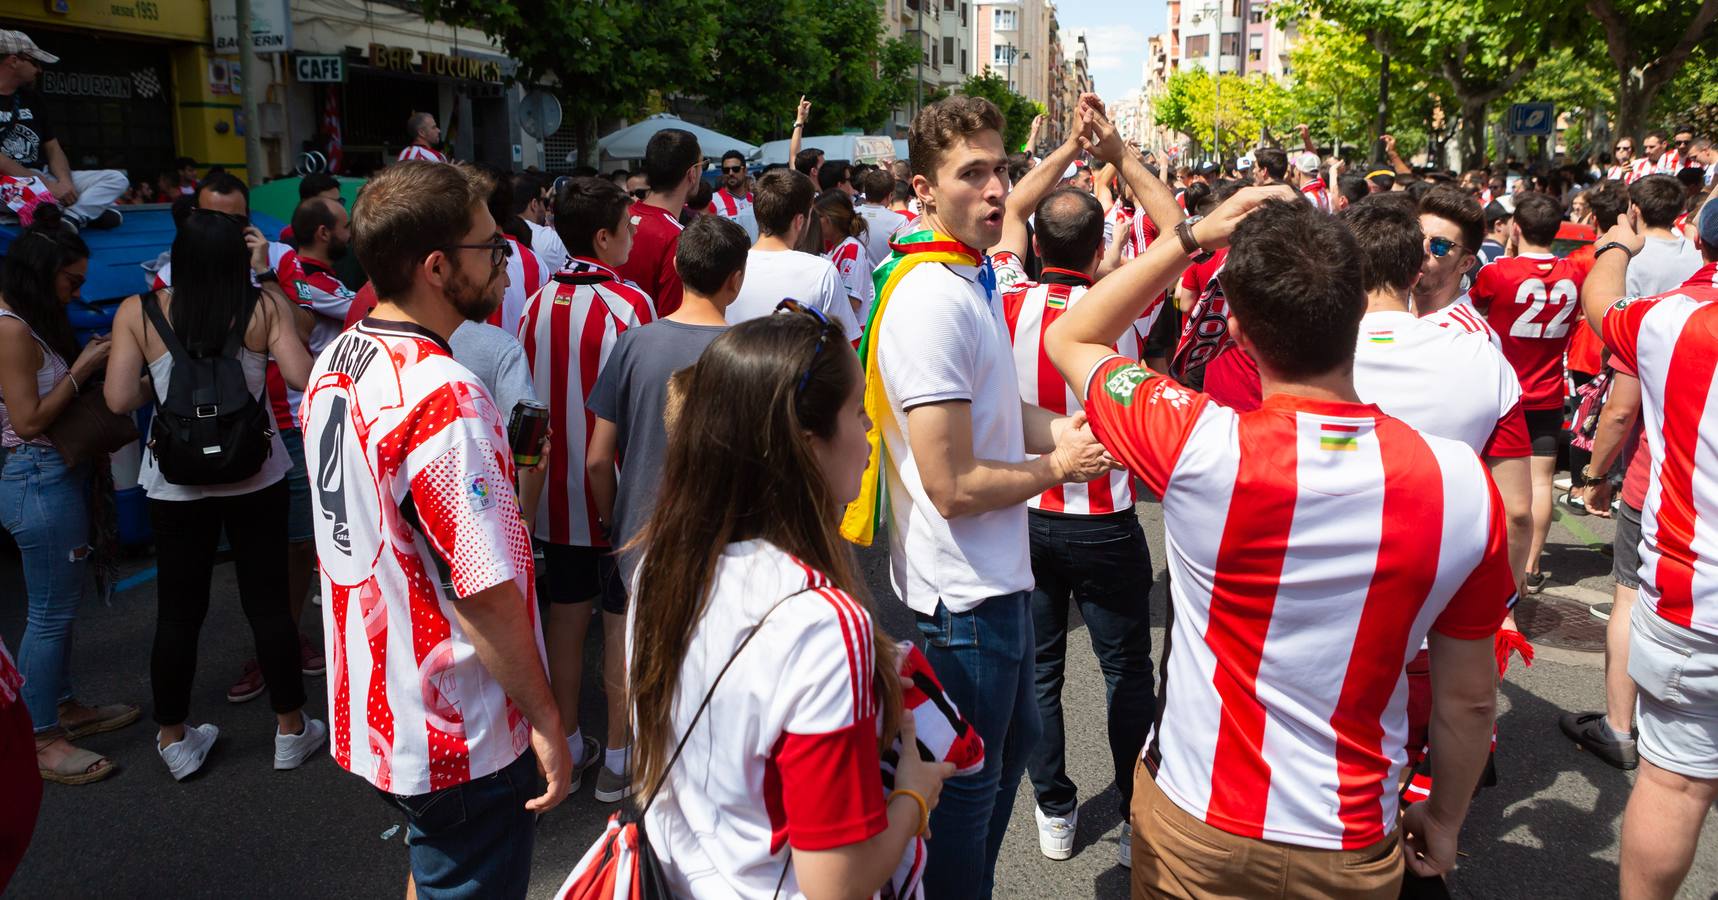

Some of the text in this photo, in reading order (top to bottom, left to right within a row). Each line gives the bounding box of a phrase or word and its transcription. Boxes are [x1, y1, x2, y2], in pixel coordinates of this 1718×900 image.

[136, 1, 159, 21] 1953
[217, 34, 284, 49] BAERIN
[299, 58, 339, 80] CAFE
[375, 44, 414, 72] BAR
[43, 71, 131, 98] BAQUERIN
[1509, 278, 1577, 339] 22
[328, 334, 379, 384] NACHO
[317, 394, 352, 556] 4
